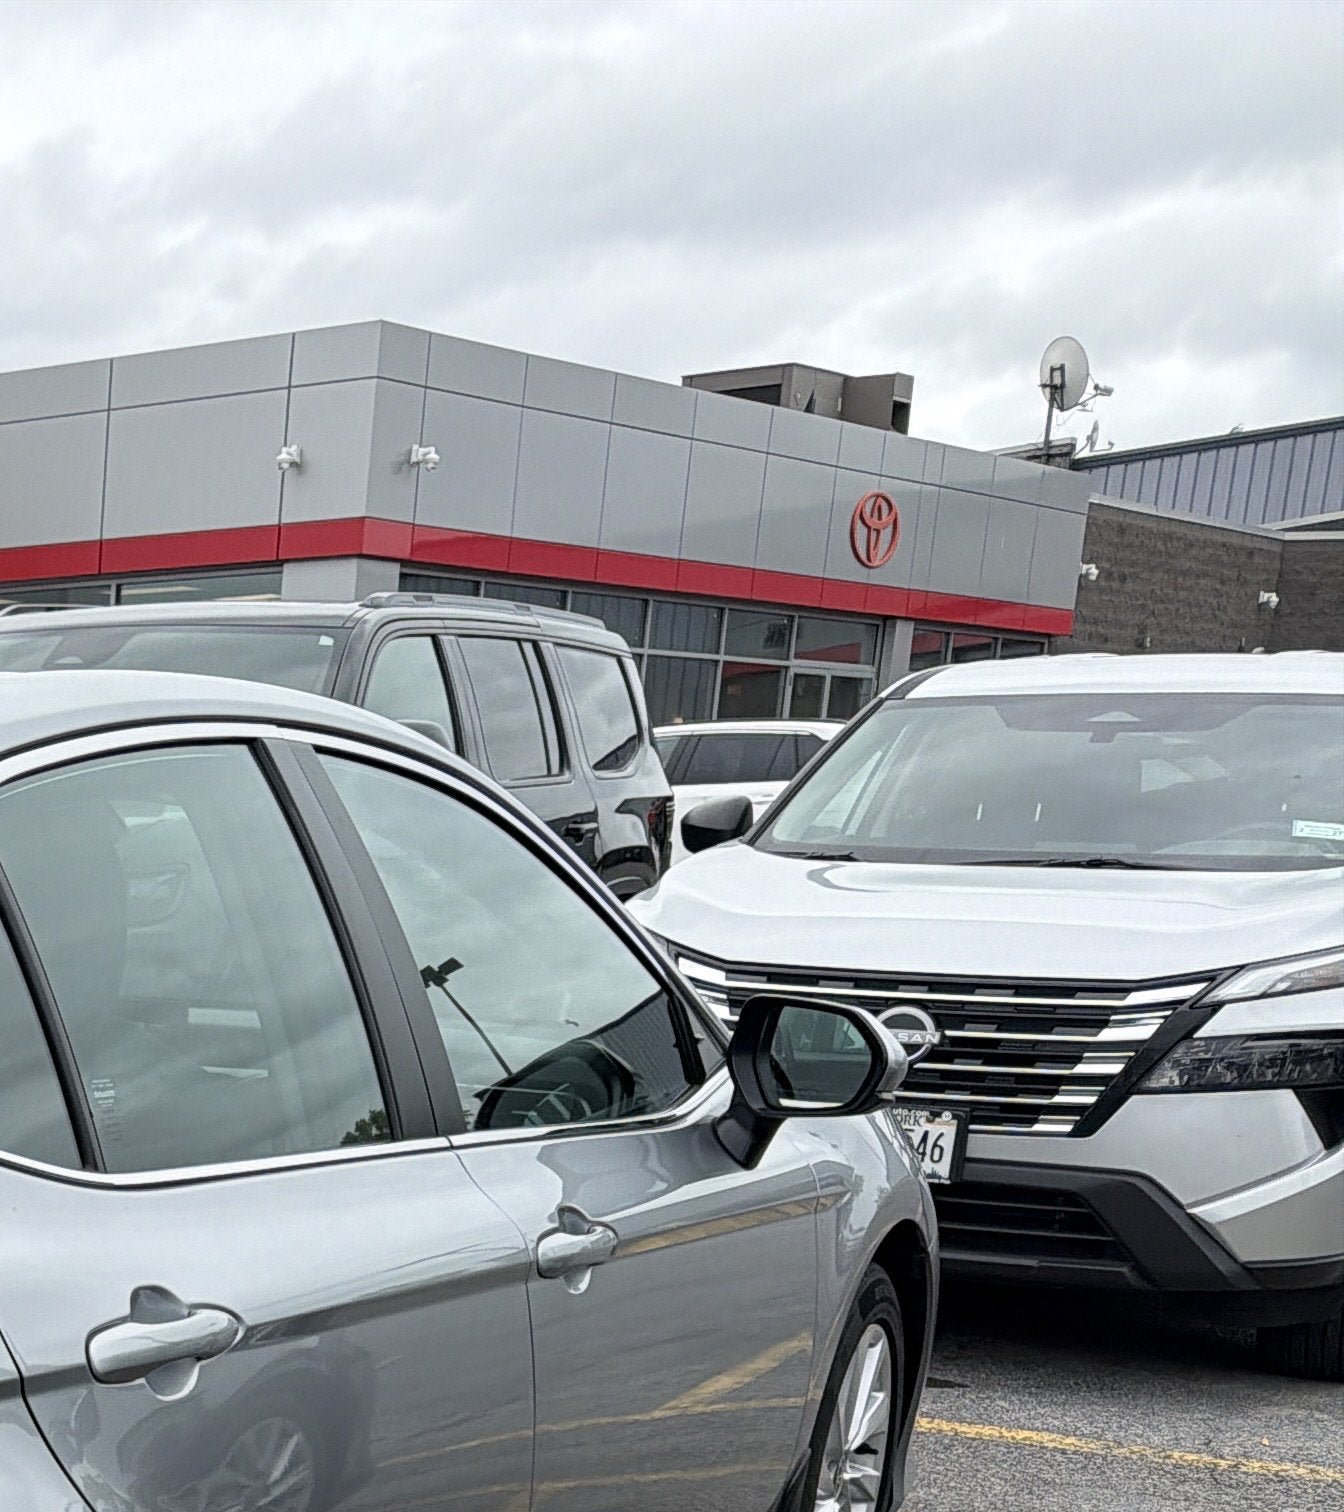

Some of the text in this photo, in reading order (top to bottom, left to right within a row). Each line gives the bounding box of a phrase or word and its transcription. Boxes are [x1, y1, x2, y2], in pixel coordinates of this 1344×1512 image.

[897, 1031, 941, 1044] SAN
[892, 1107, 930, 1118] uto.com
[896, 1114, 923, 1127] ORK
[904, 1129, 945, 1163] 46
